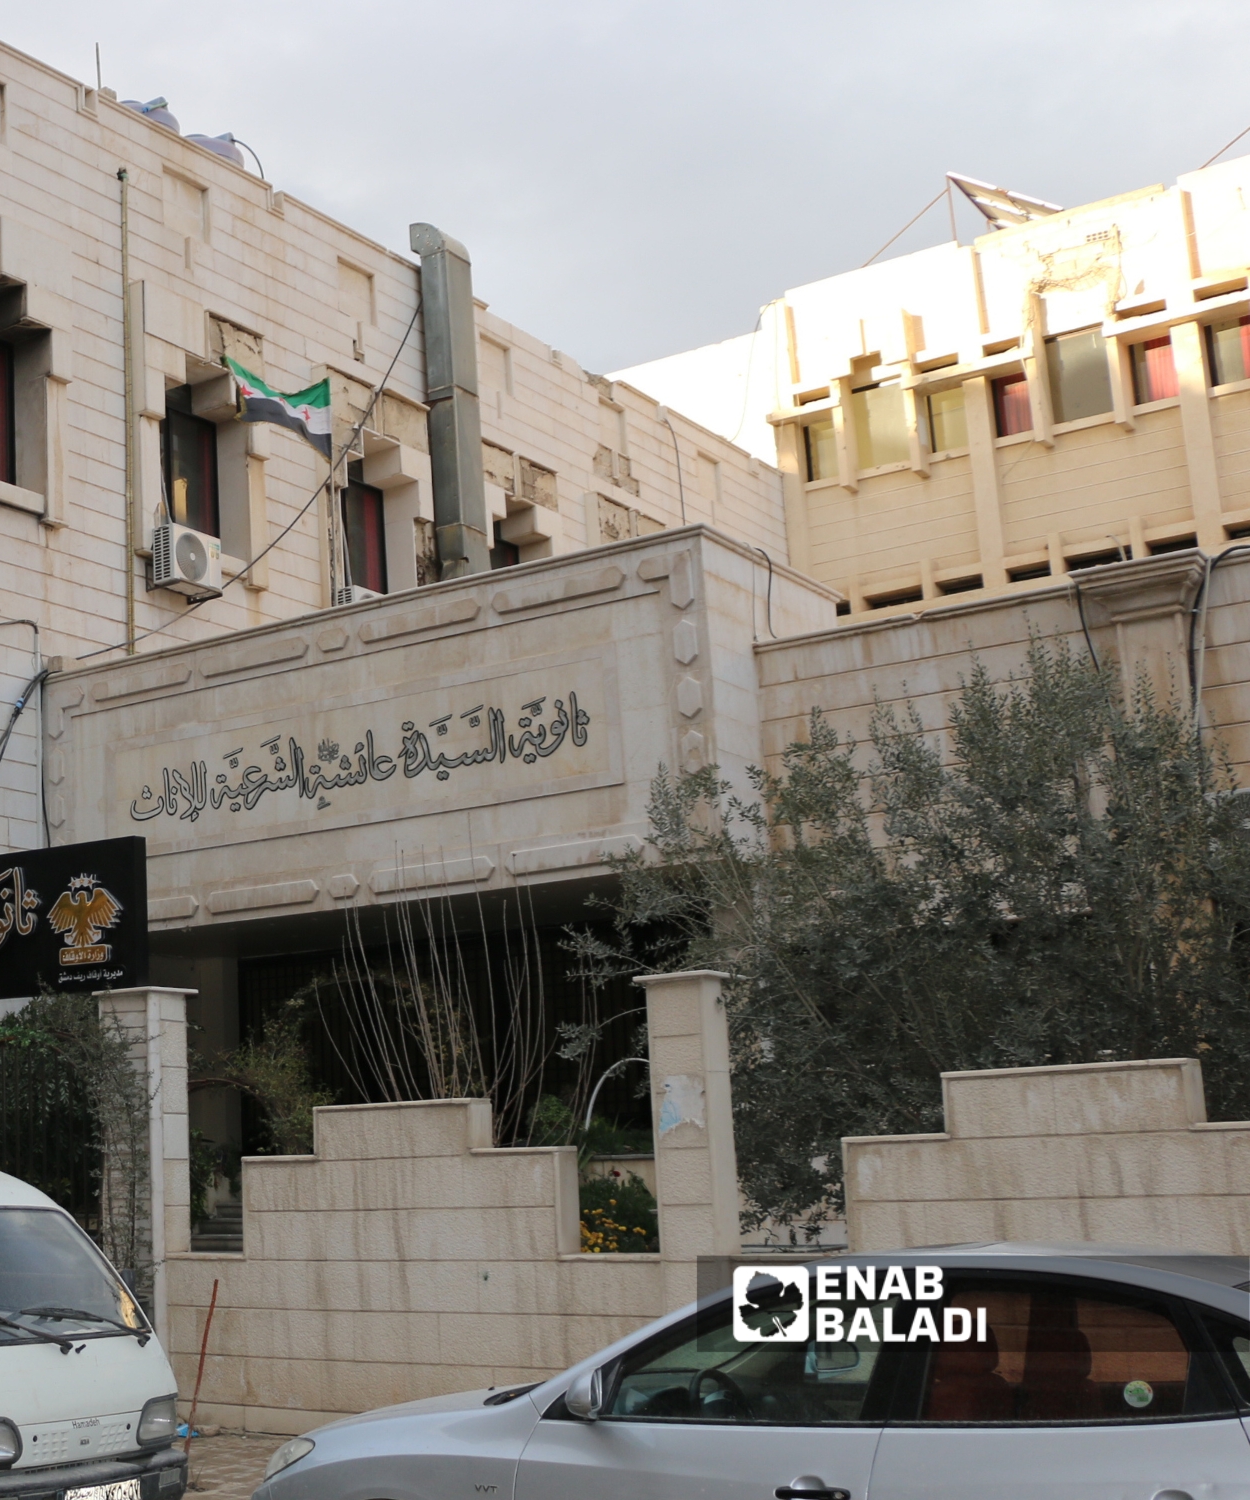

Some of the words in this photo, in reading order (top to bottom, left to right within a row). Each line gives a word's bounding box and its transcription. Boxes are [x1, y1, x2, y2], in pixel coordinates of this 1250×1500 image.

[399, 704, 506, 781] السيدة
[508, 691, 591, 763] ثانوية
[210, 734, 306, 812] الشرعية
[304, 729, 398, 805] عائشة
[87, 949, 104, 961] وزارة
[72, 1417, 101, 1429] Hamadeh
[474, 1484, 499, 1494] VVT
